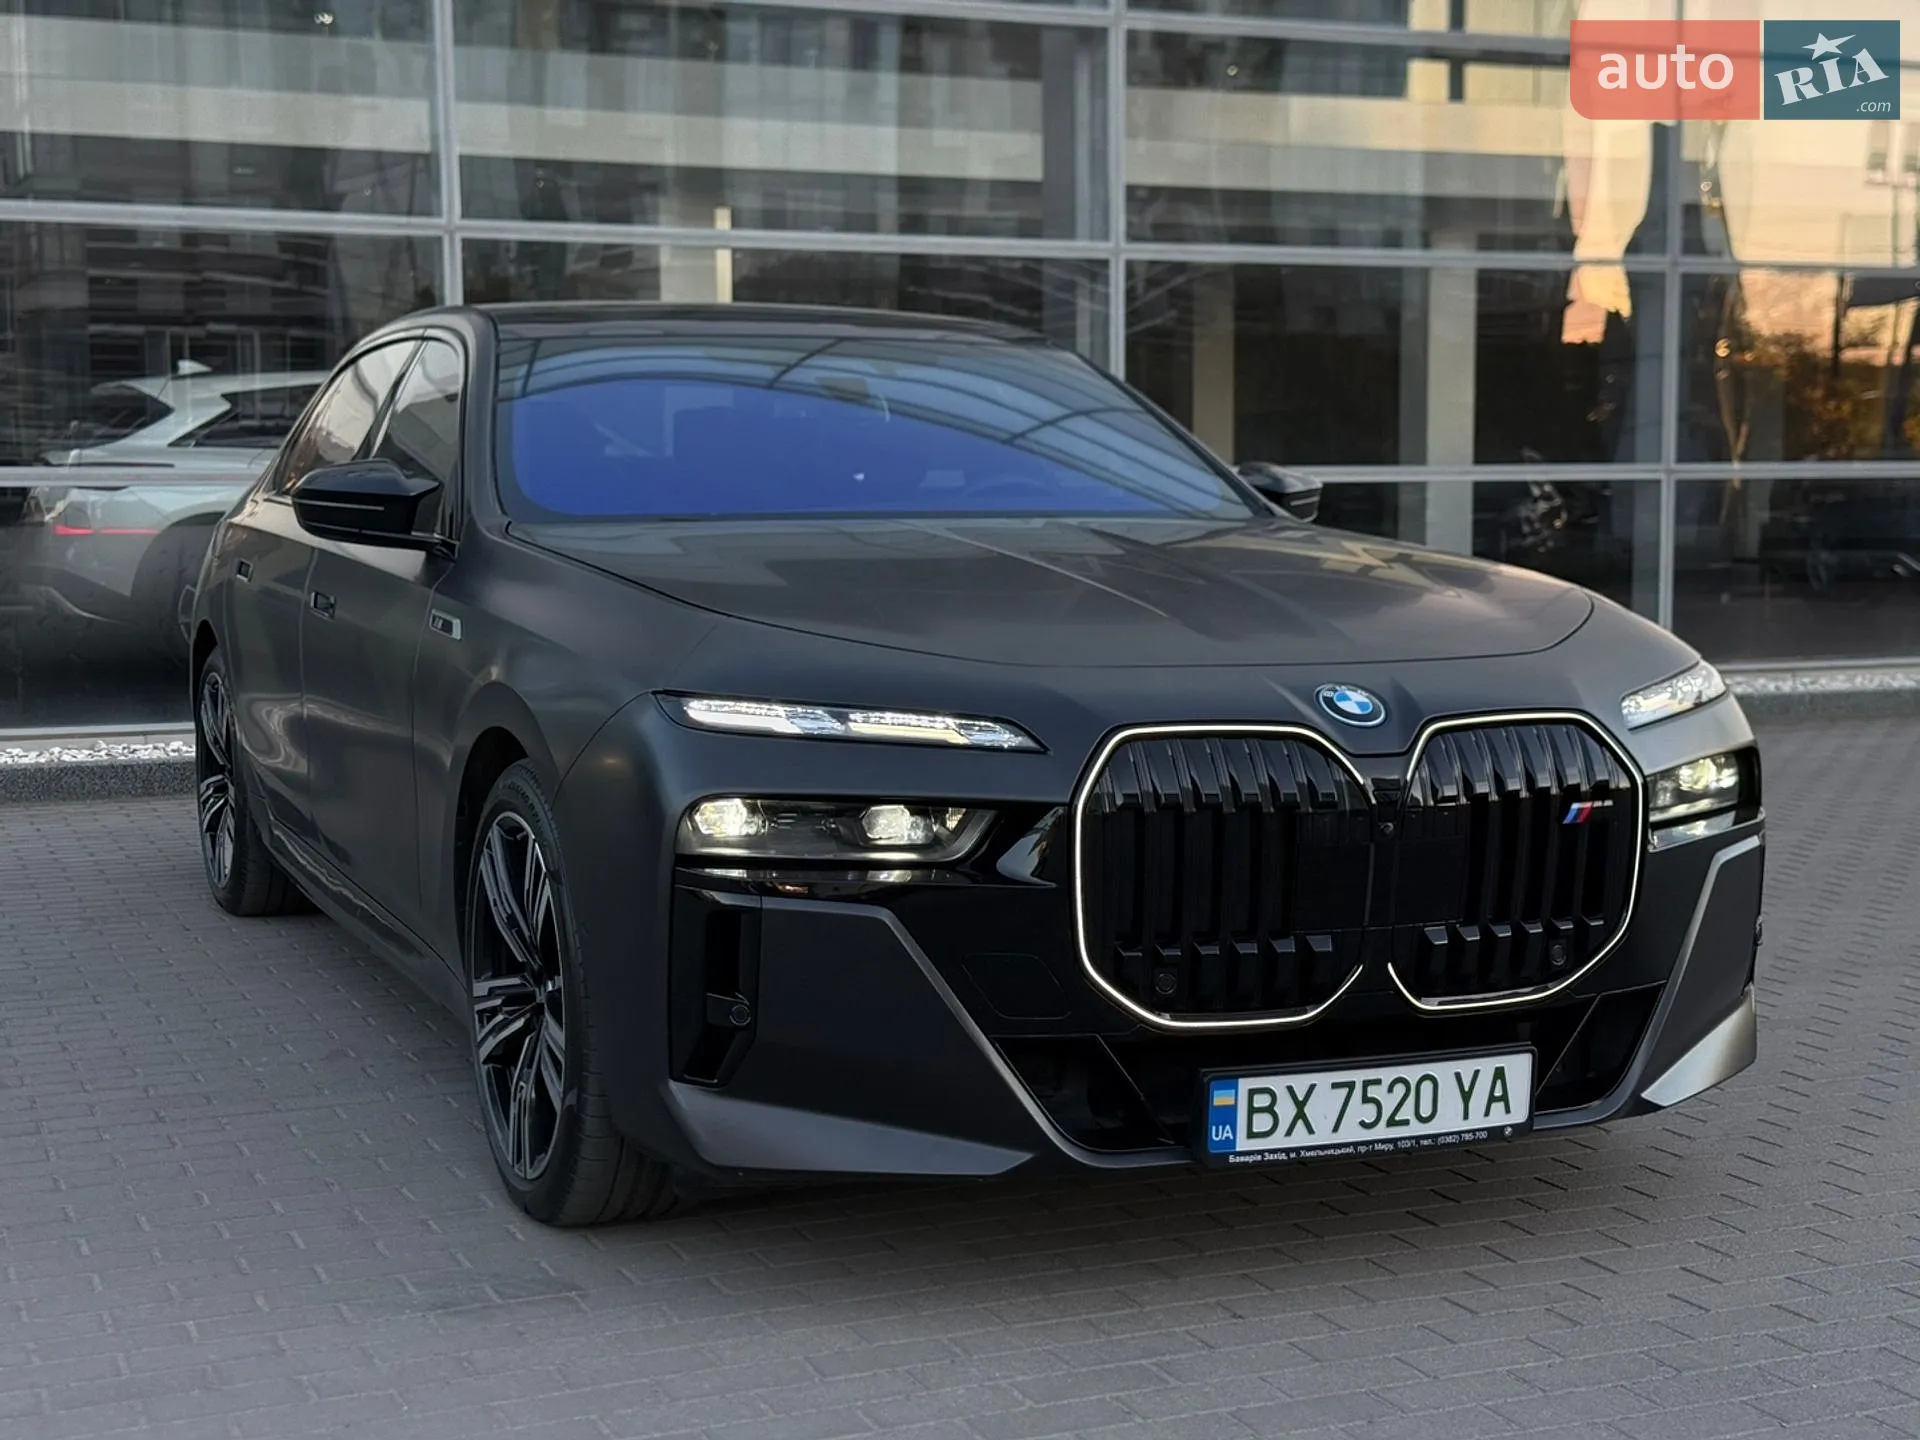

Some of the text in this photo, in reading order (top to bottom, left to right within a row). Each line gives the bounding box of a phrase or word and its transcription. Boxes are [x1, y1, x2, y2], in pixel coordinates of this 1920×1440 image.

[1246, 1065, 1512, 1141] BX 7520 YA
[1212, 1124, 1234, 1142] UA
